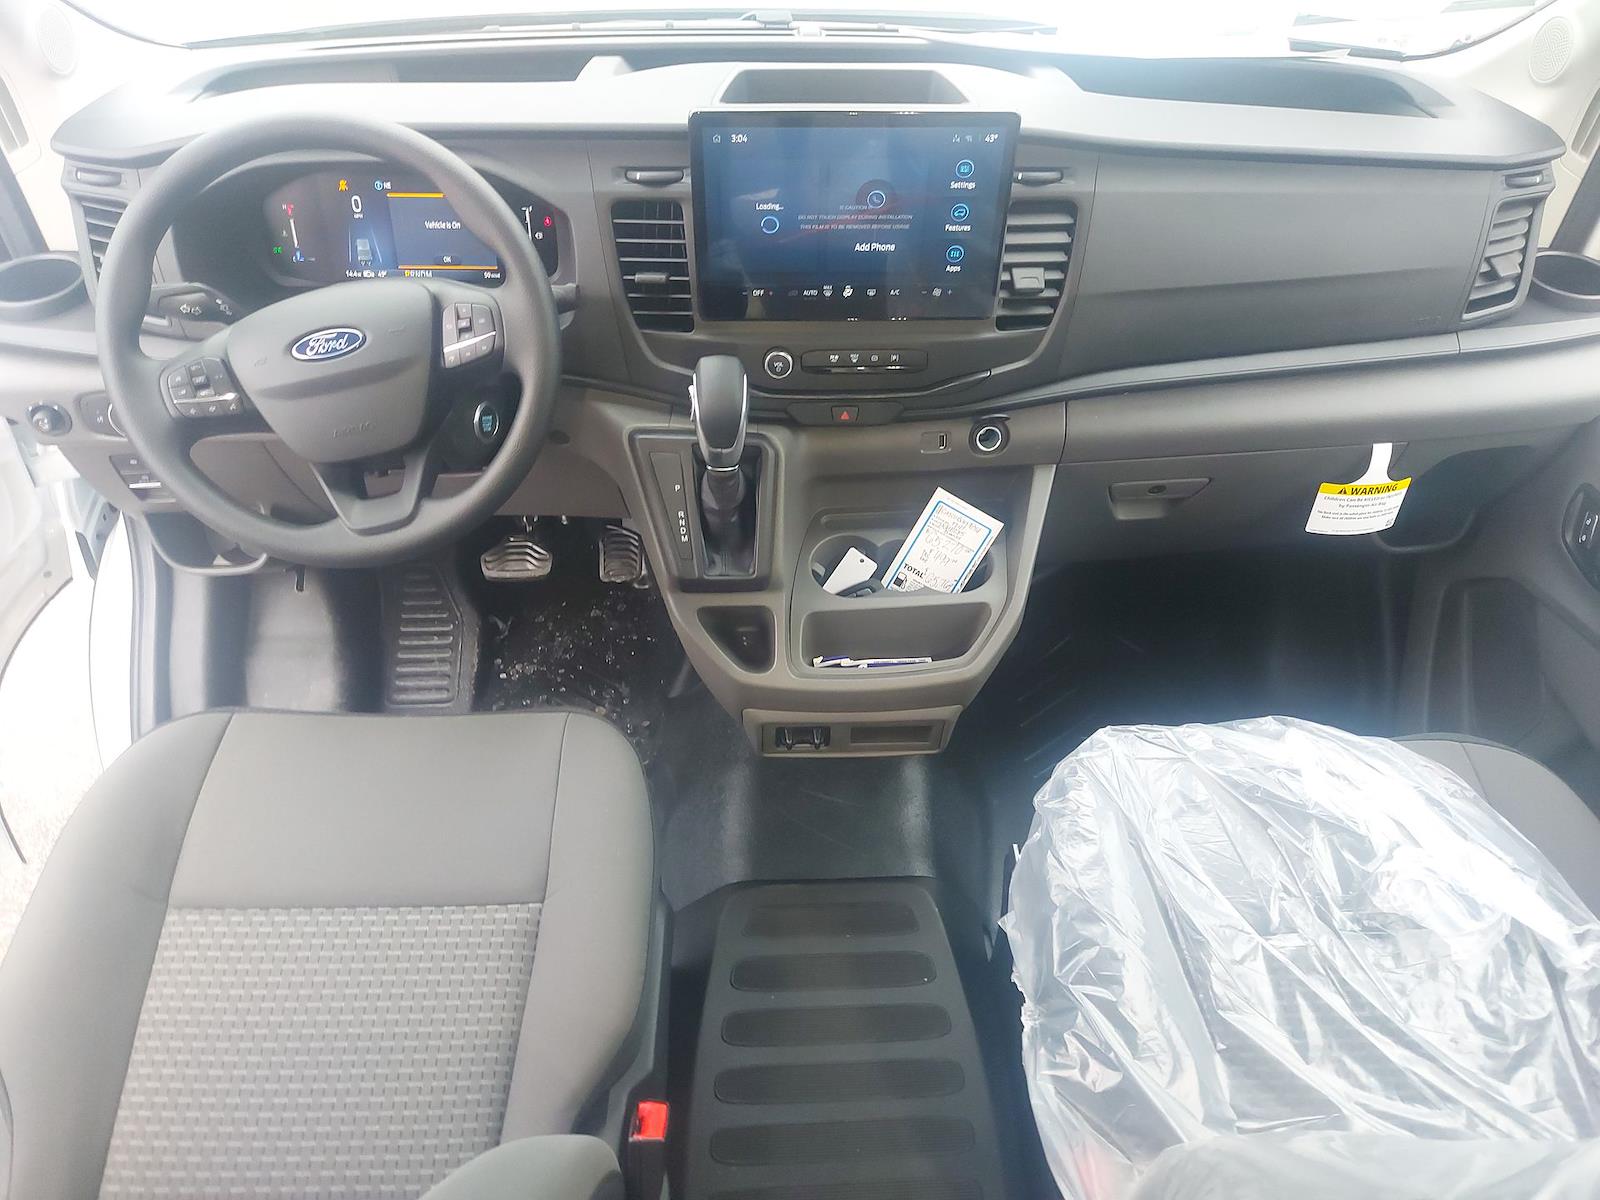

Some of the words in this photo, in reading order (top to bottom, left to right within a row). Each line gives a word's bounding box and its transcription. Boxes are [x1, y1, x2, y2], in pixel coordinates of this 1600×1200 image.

[730, 133, 748, 143] 3:04
[950, 181, 976, 190] Settings
[351, 195, 362, 213] 0
[424, 221, 446, 229] Vehicle
[451, 221, 461, 229] On
[854, 243, 870, 252] Add
[870, 243, 895, 252] Phone
[890, 288, 900, 296] A/C
[306, 332, 349, 357] Ford
[1351, 484, 1398, 496] WARNING
[903, 563, 924, 579] TOTAL
